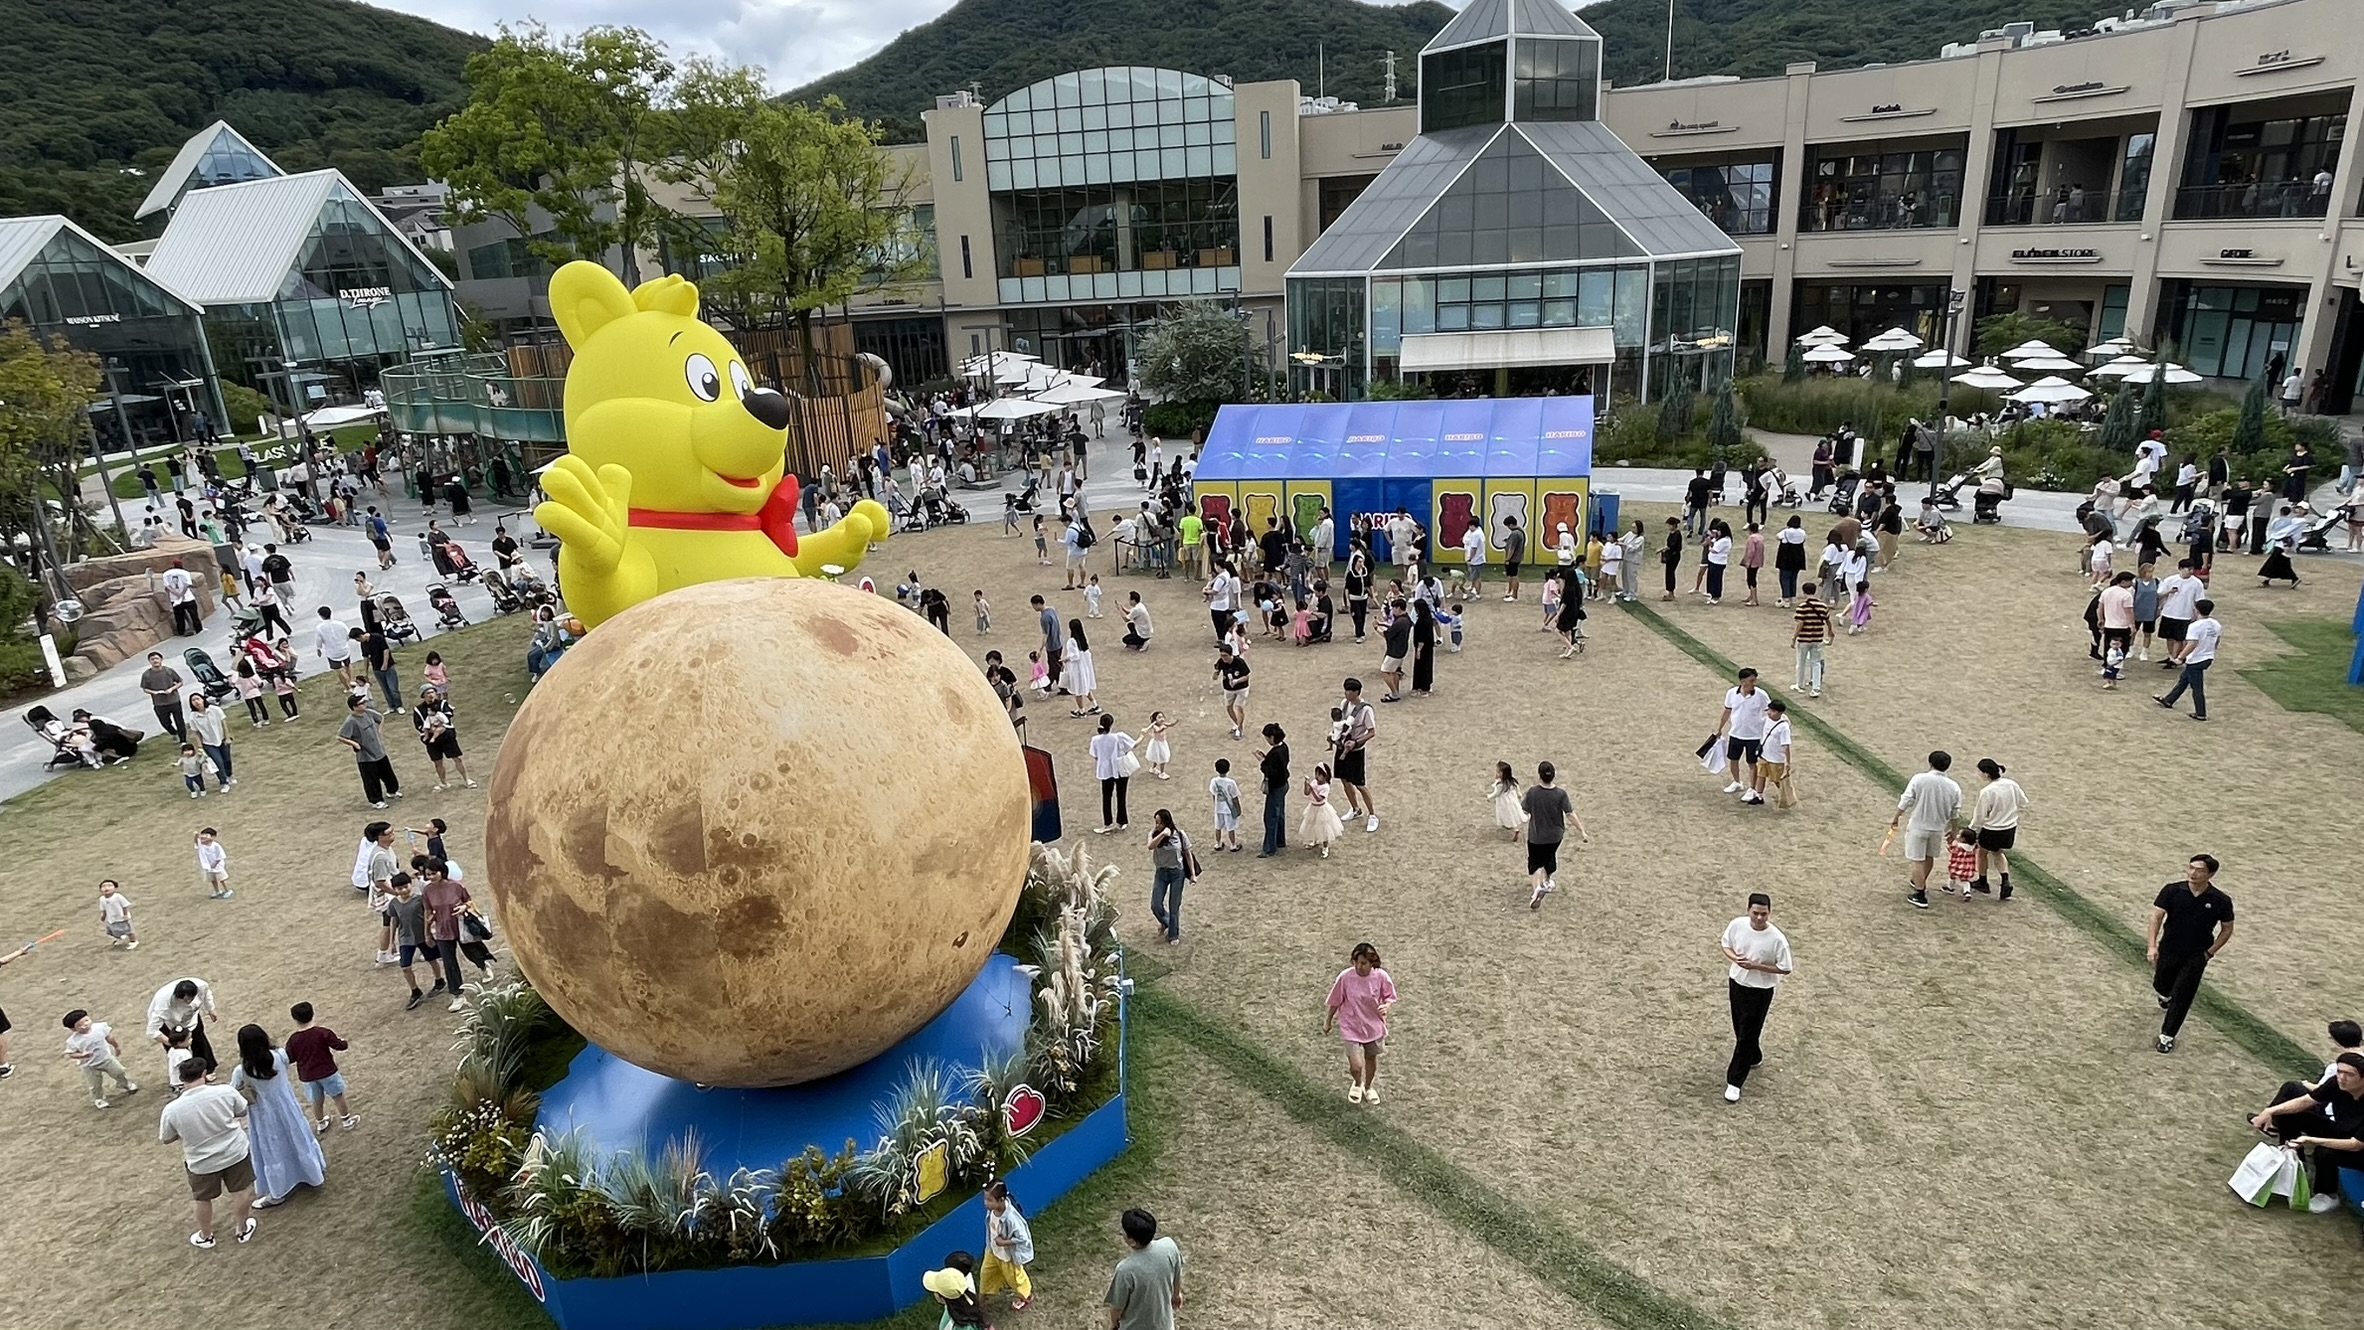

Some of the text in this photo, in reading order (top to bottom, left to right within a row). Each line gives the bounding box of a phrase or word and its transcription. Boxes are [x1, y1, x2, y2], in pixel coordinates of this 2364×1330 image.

[339, 286, 392, 299] D.THRONE
[1348, 434, 1386, 443] HARIBO
[1444, 433, 1484, 442] HARIBO
[1545, 430, 1586, 439] HARIBO
